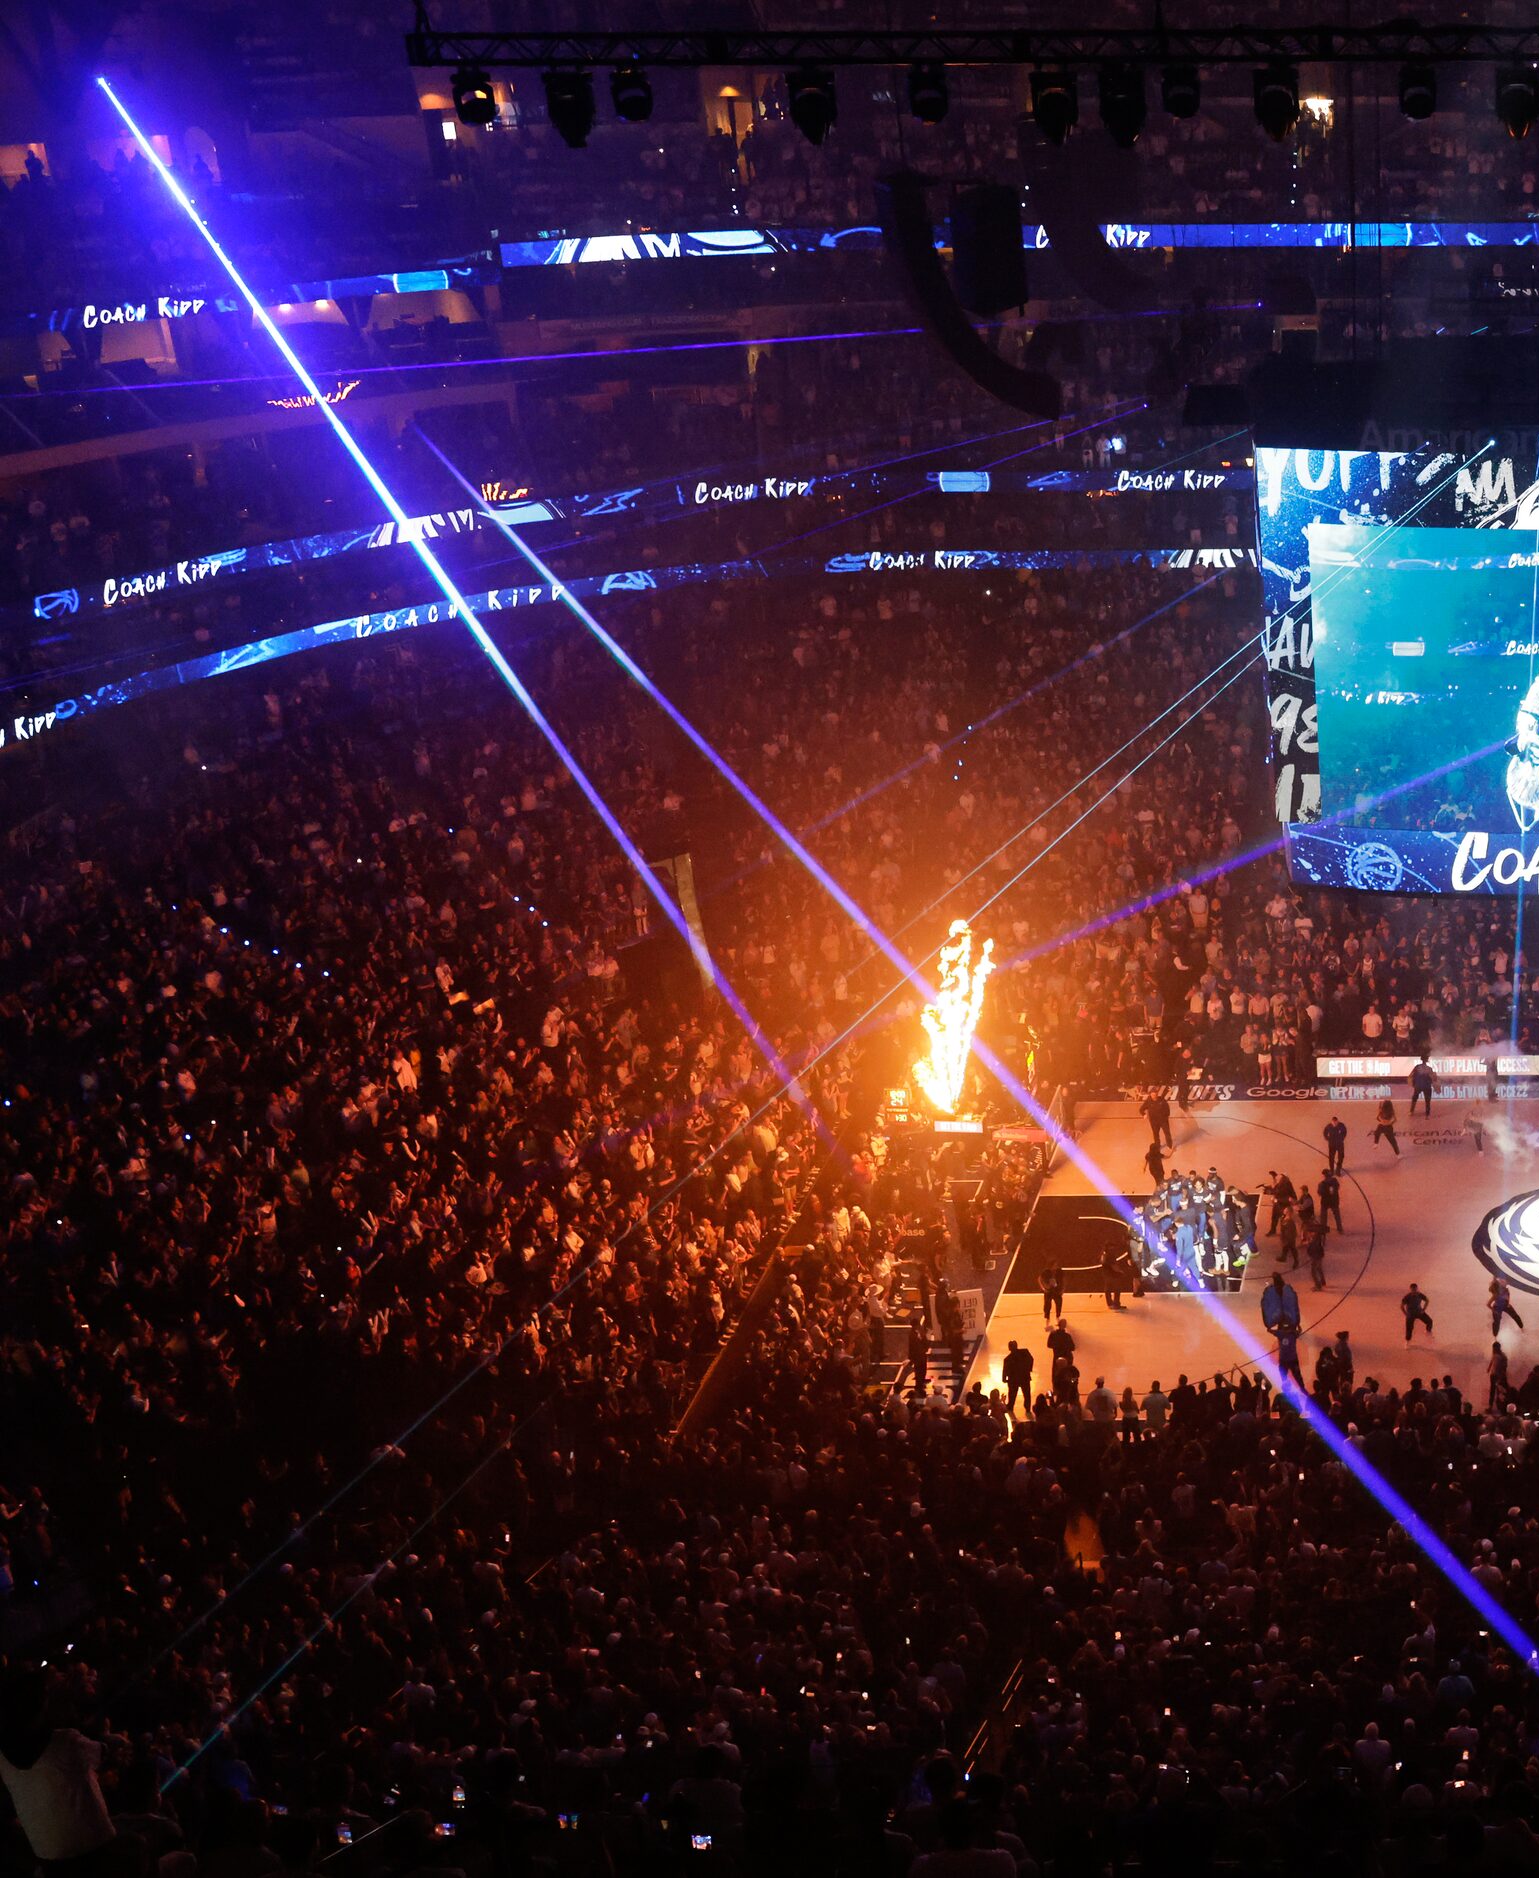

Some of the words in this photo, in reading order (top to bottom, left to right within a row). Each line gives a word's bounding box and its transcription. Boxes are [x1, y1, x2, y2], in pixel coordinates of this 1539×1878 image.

[1117, 470, 1174, 491] COACH
[695, 482, 754, 504] COACH
[103, 571, 166, 606] COACH
[1328, 1060, 1345, 1075] GET
[1346, 1060, 1364, 1075] THE
[1246, 1086, 1328, 1099] Google
[1367, 1129, 1440, 1137] Aerican
[1413, 1138, 1463, 1146] Center
